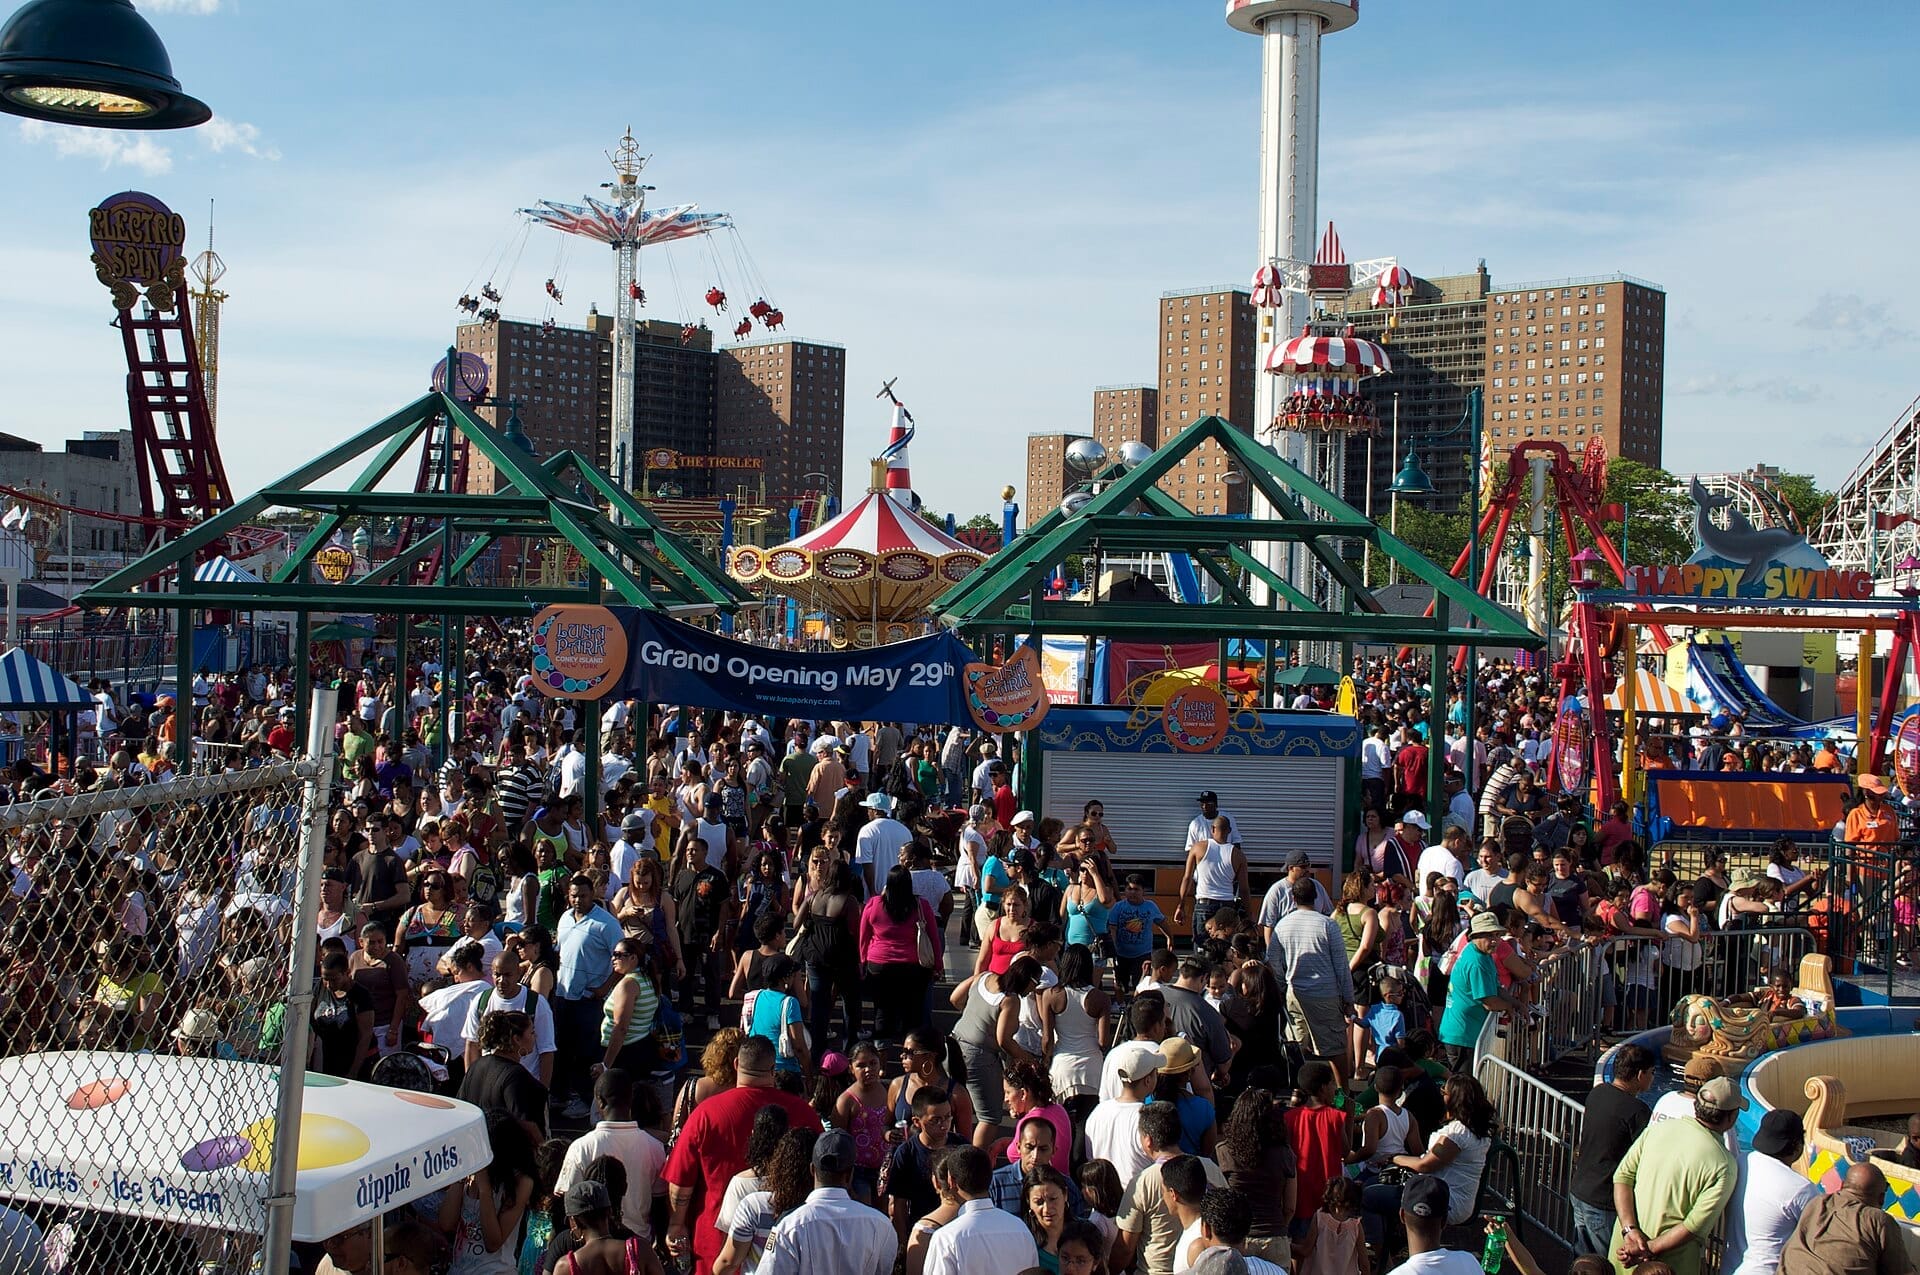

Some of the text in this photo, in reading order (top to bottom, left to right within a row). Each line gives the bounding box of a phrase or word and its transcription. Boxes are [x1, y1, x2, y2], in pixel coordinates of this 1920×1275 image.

[89, 209, 184, 246] ELECTRO
[112, 246, 161, 281] SPIN
[680, 457, 761, 468] THE TICKLER
[1636, 565, 1874, 599] HAPPY SWING
[557, 623, 605, 640] LUNA
[555, 638, 606, 656] PARK
[641, 640, 954, 691] Grand Opening May 29th
[755, 695, 840, 706] www.lunaparknyc.com
[1008, 690, 1031, 700] ISLAND
[1184, 701, 1215, 711] LUNA
[1184, 710, 1215, 721] PARK
[424, 1144, 459, 1180] dots
[113, 1171, 143, 1201] Ice
[150, 1176, 220, 1213] Cream
